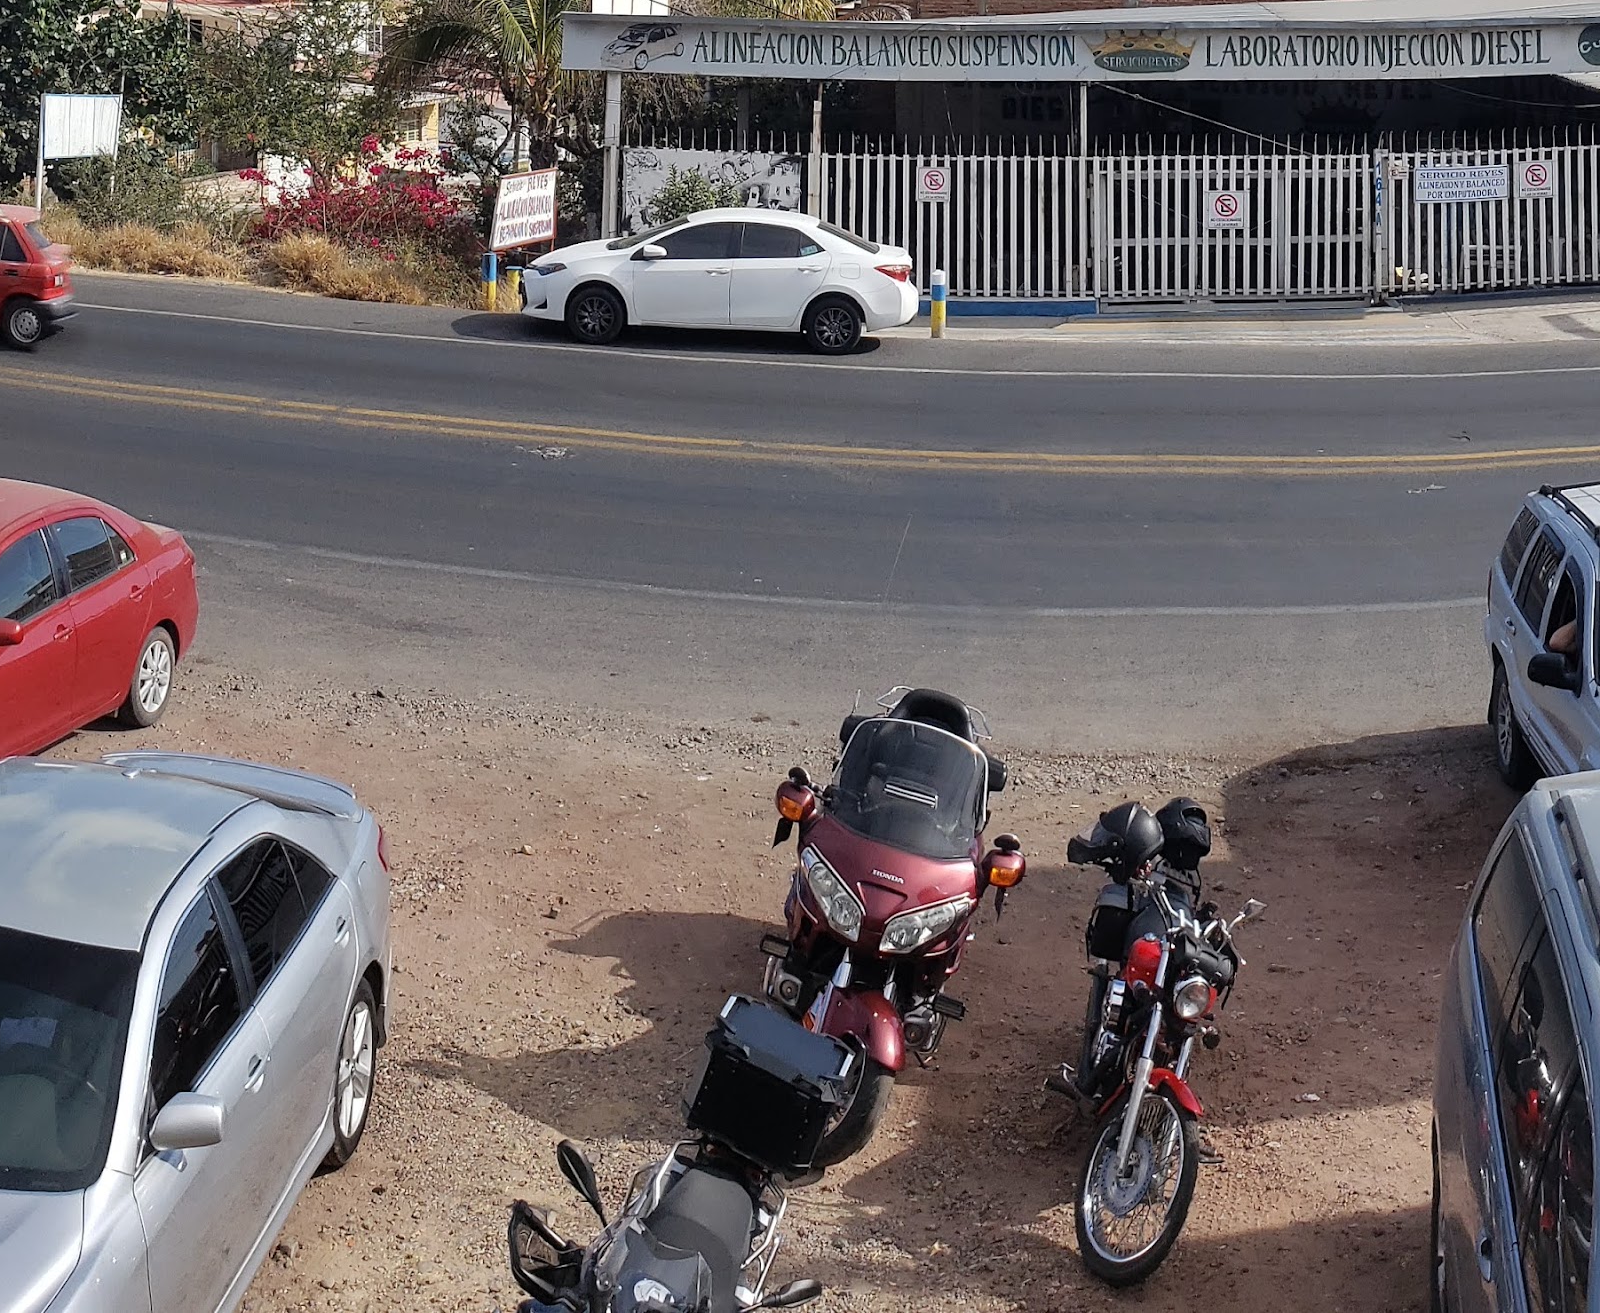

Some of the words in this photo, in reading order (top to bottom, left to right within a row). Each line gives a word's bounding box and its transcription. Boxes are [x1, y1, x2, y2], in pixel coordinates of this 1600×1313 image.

[1204, 34, 1360, 68] LABORATORIO
[1363, 30, 1466, 73] INJECCION
[1470, 28, 1552, 66] DIESEL
[1102, 56, 1147, 68] SERVICIO
[1148, 56, 1182, 68] REYES
[1419, 171, 1467, 179] SERVICIO
[1469, 169, 1505, 178] REYES
[1466, 178, 1506, 188] BALANCEO
[1427, 190, 1444, 199] POR
[872, 869, 904, 885] HONDA
